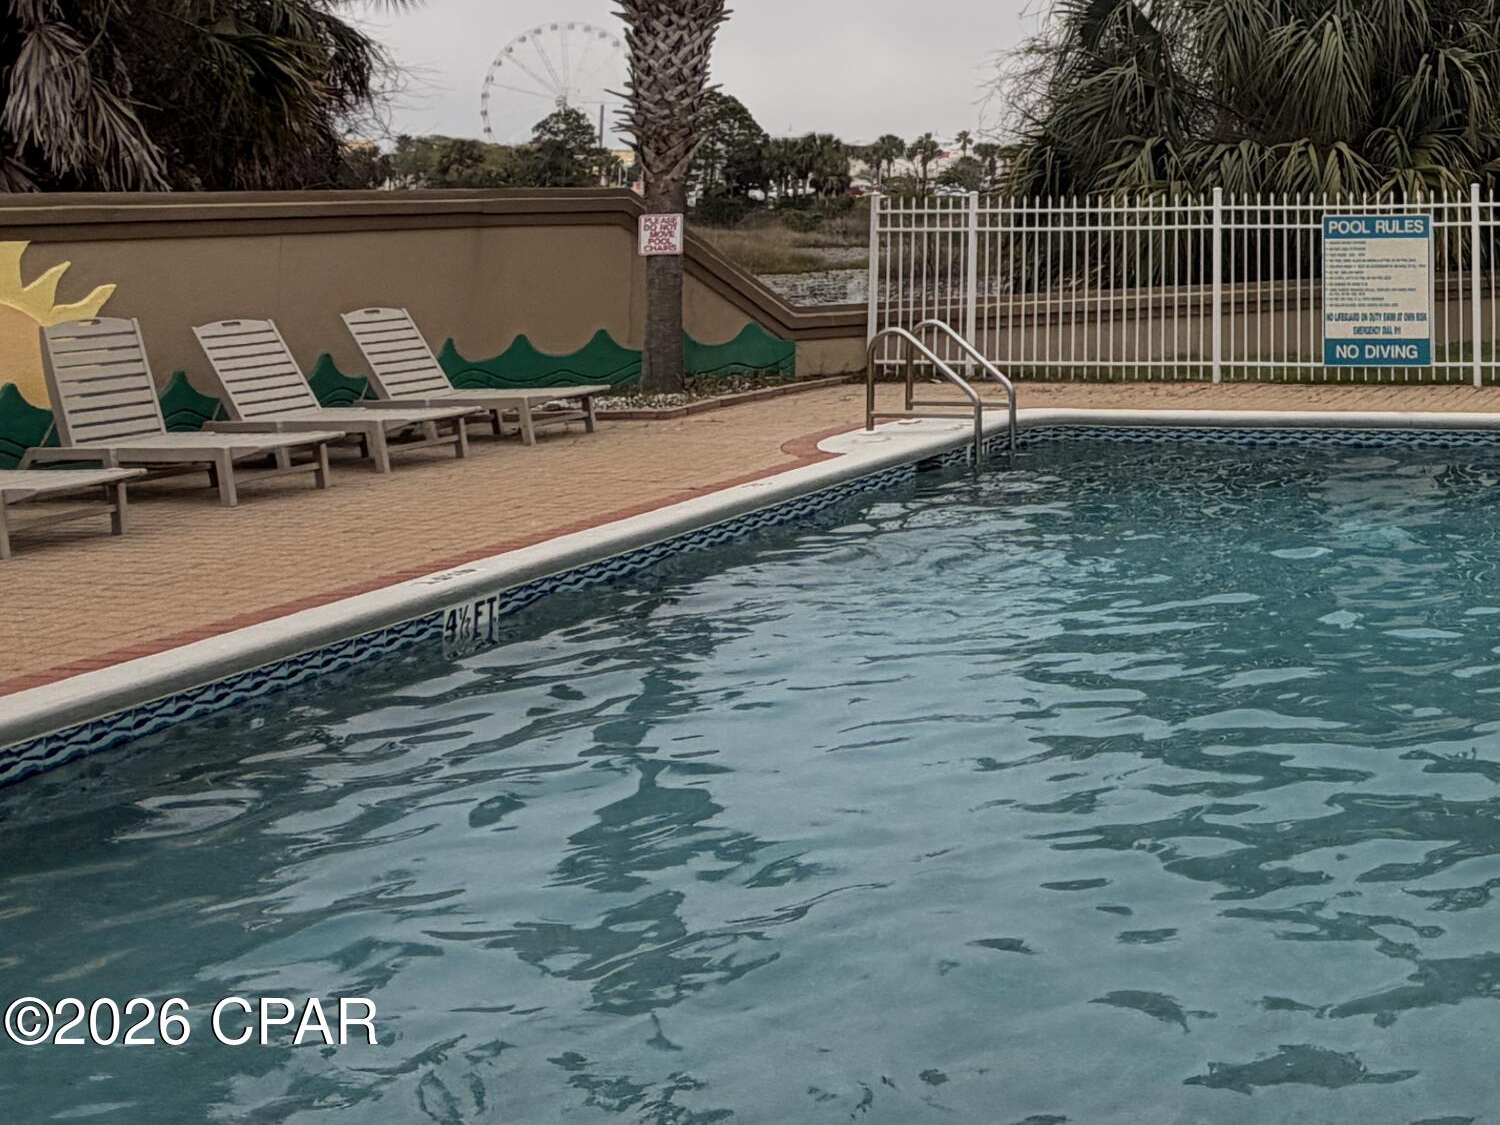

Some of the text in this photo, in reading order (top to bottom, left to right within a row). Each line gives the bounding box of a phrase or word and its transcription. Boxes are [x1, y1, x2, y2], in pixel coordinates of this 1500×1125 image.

[644, 217, 677, 225] PLEASE
[643, 224, 657, 232] DO
[1328, 219, 1424, 234] POOL RULES
[643, 244, 677, 252] CHAIRS
[1326, 313, 1334, 322] NO
[1334, 313, 1360, 322] LIFEGUARD
[1368, 313, 1382, 322] DUTY
[1353, 326, 1381, 335] EMERGENCY
[1335, 344, 1419, 359] NO DIVING
